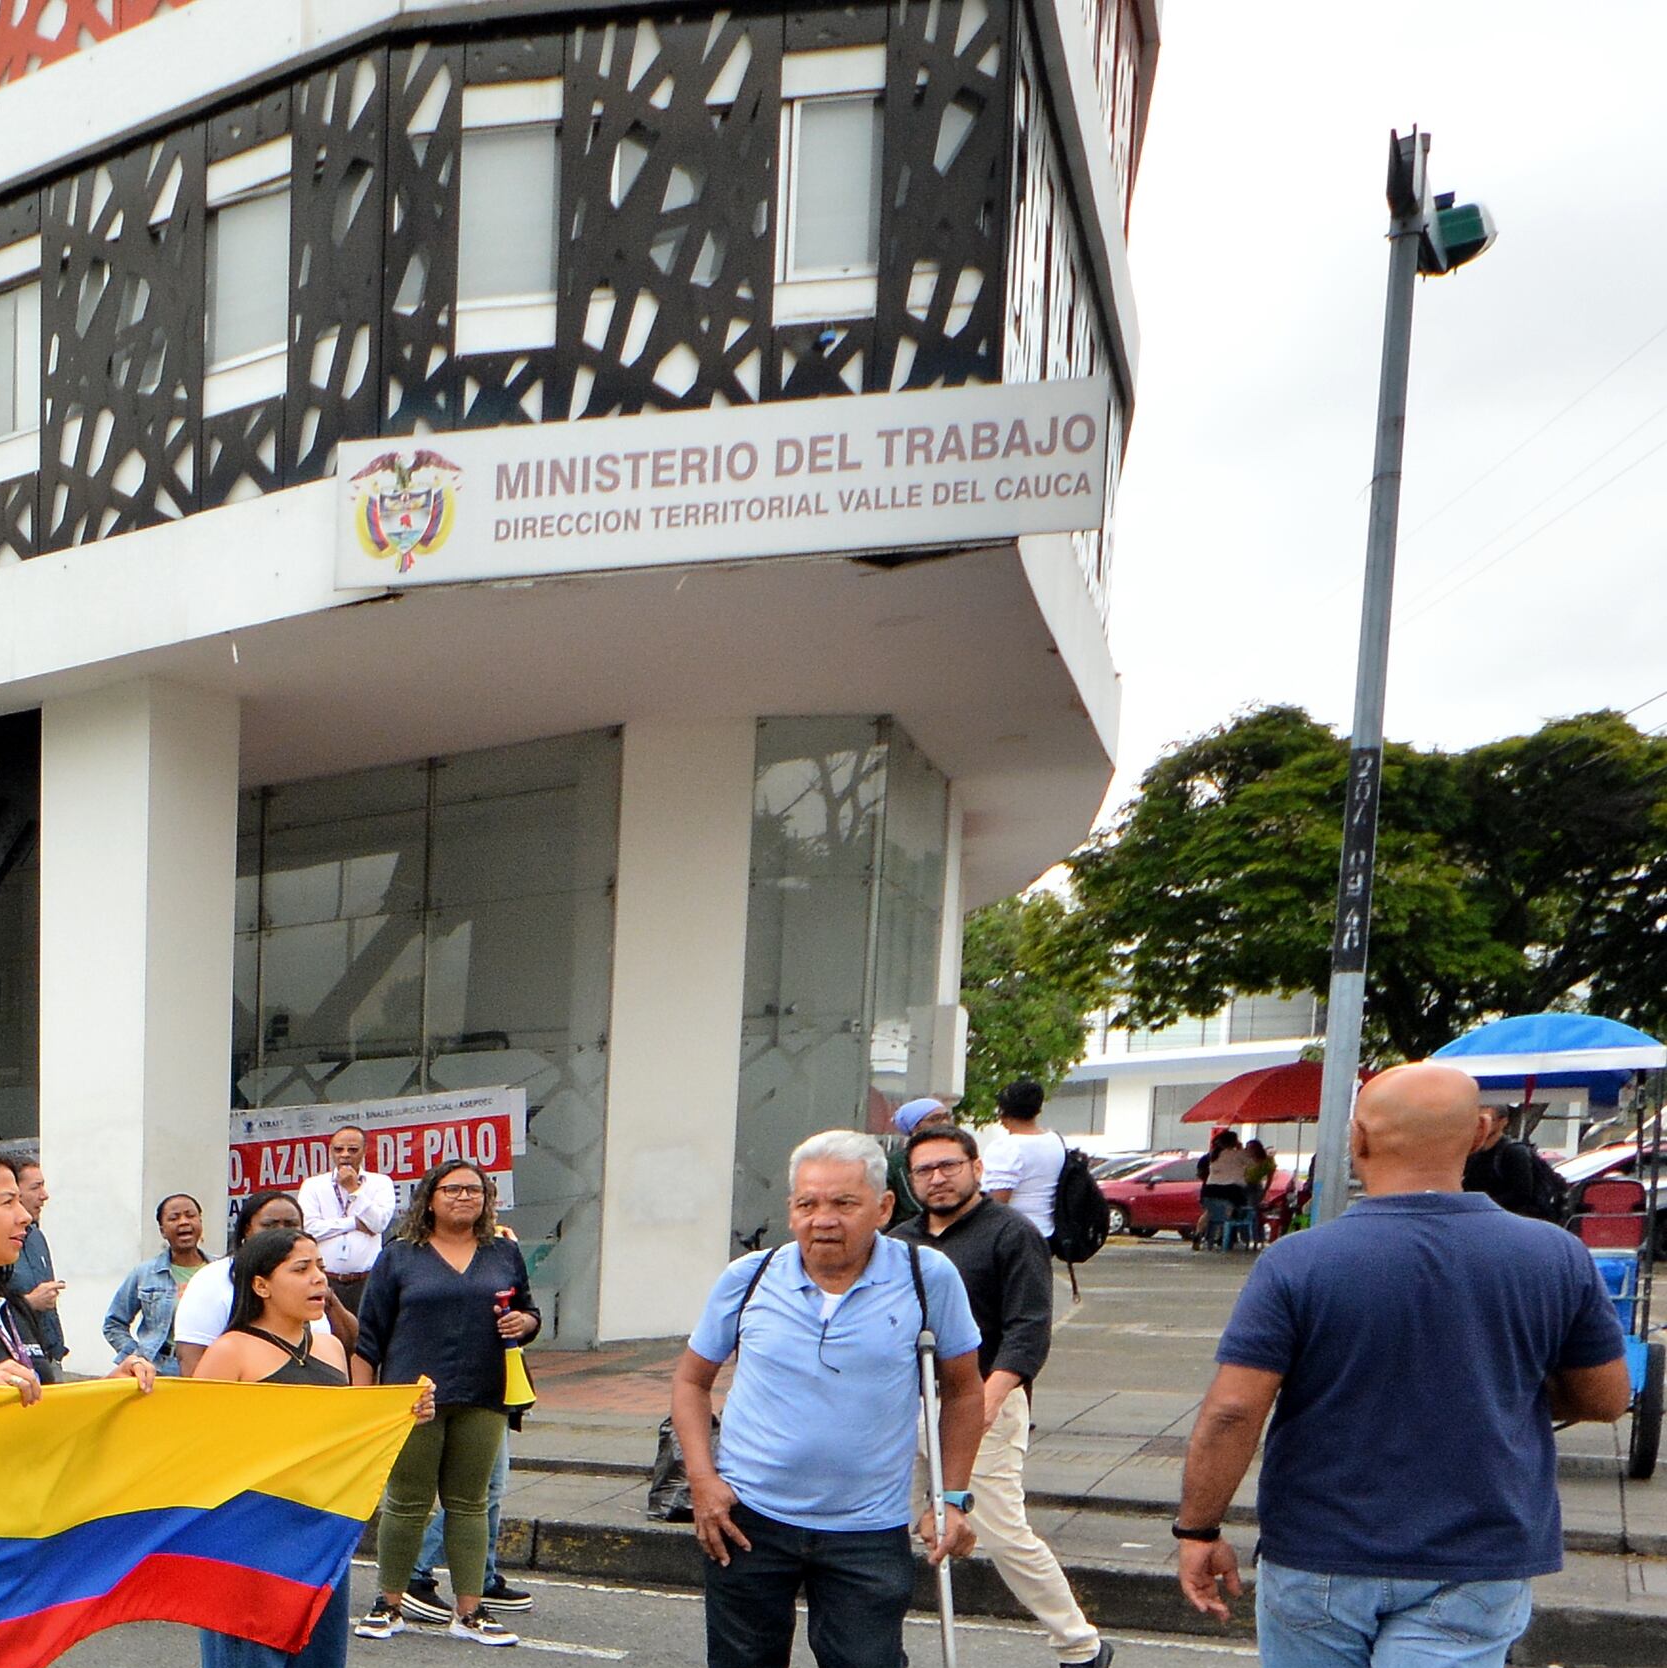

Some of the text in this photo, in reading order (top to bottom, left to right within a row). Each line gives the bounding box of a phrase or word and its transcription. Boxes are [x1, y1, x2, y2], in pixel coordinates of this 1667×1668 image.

[495, 413, 1098, 502] MINISTERIO DEL TRABAJO
[494, 472, 1092, 543] DIRECCION TERRITORIAL VALLE DEL CAUCA
[259, 1139, 339, 1186] AZAD
[377, 1132, 414, 1175] DE
[423, 1122, 497, 1170] PALO
